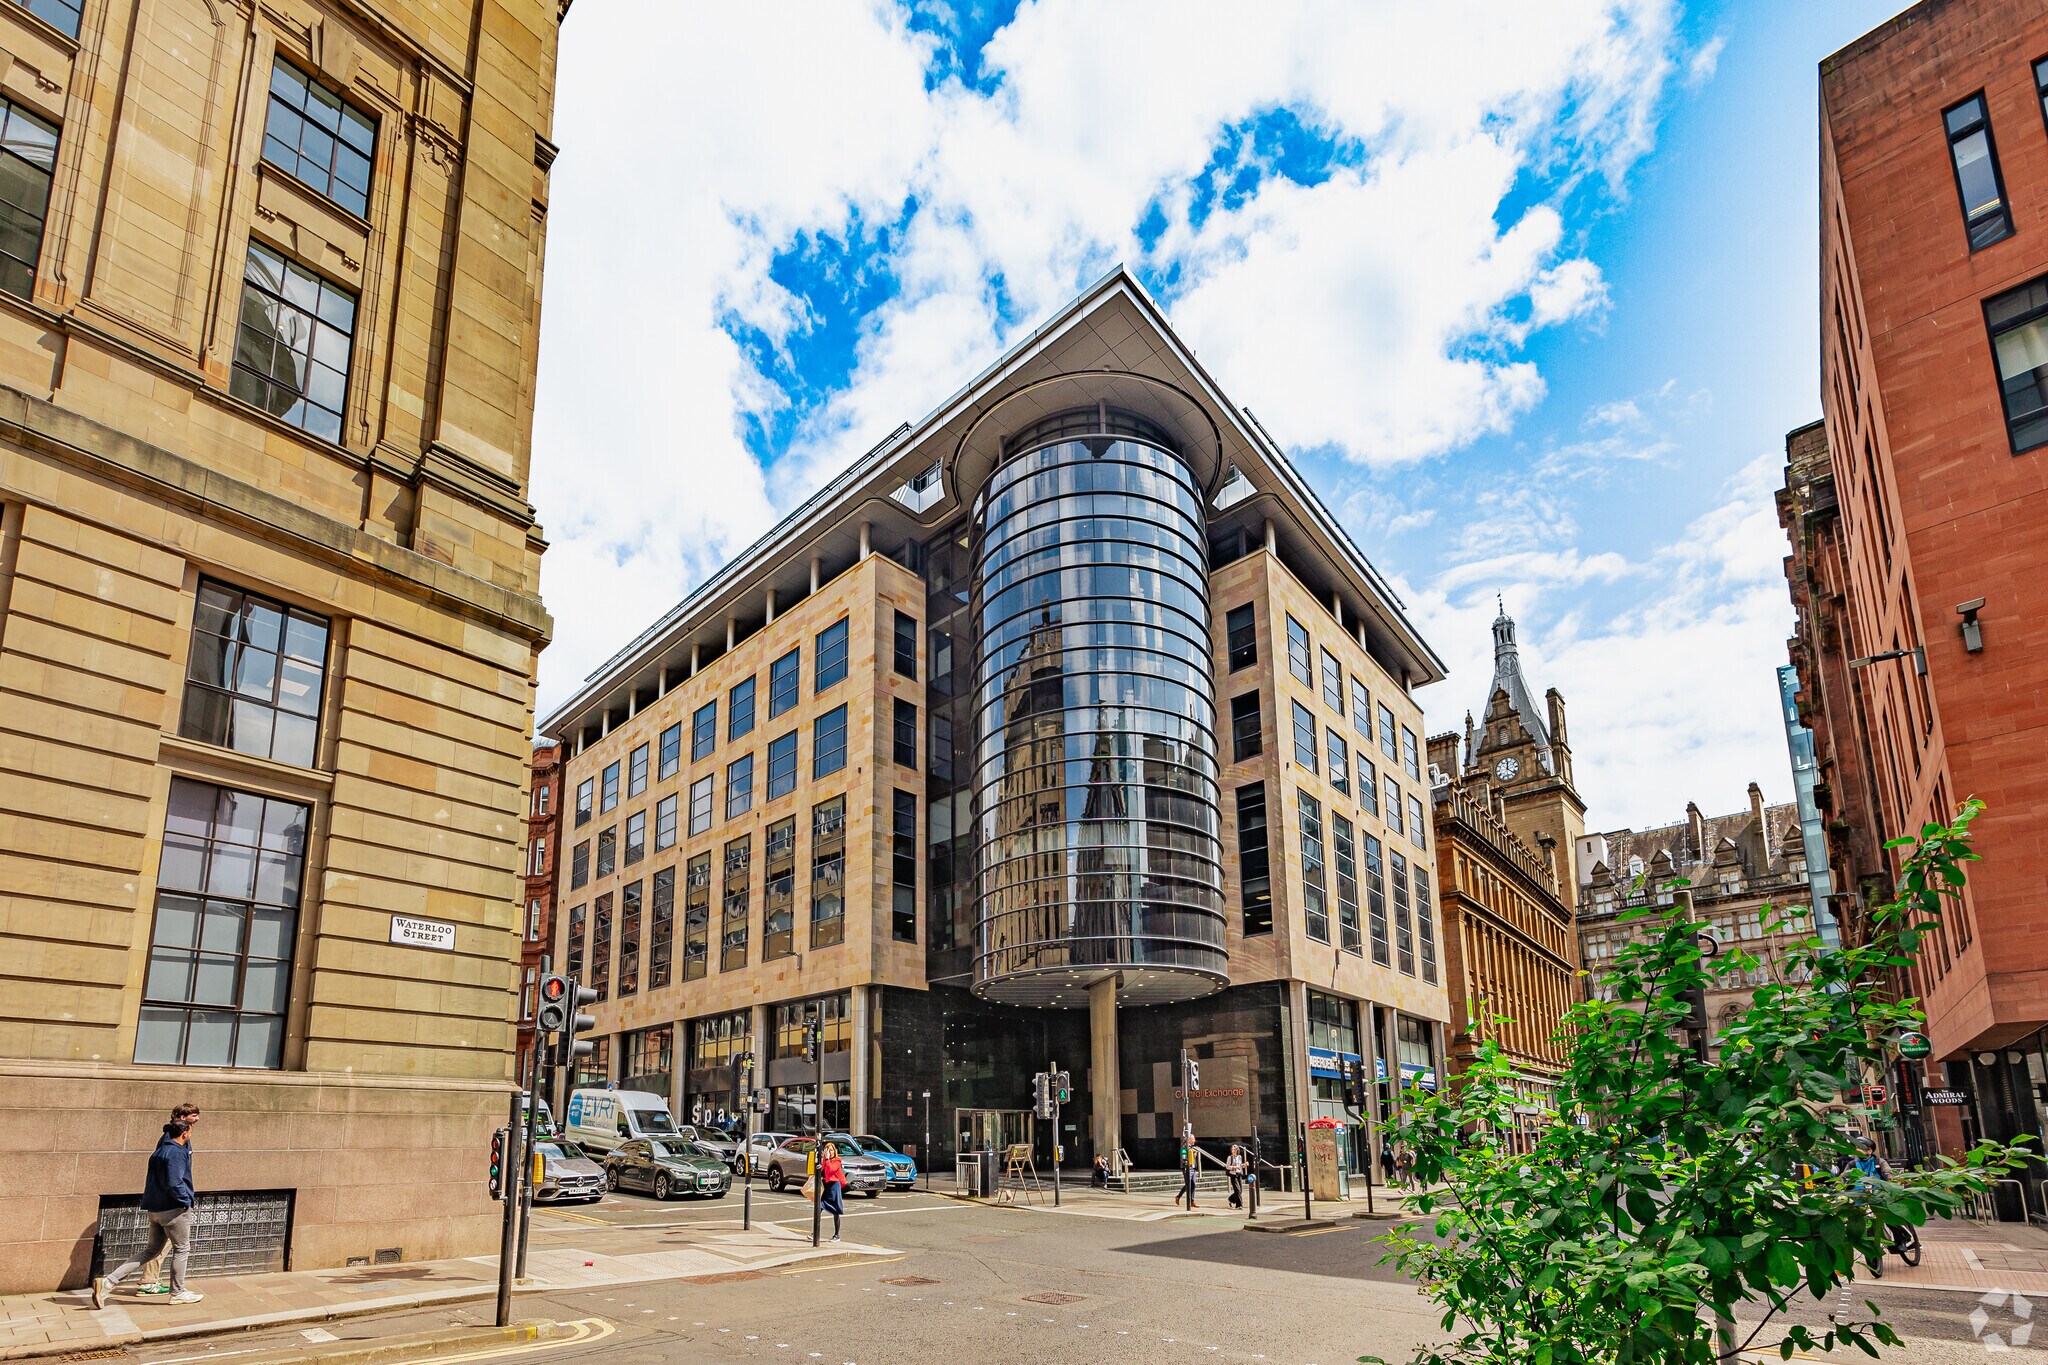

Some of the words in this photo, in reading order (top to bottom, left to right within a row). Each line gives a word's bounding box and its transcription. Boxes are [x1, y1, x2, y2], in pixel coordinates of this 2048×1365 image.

[396, 919, 452, 934] WATERLOO
[403, 929, 443, 942] STREET
[1204, 1088, 1244, 1098] Exchange
[1925, 1091, 1967, 1099] ADMIRAL
